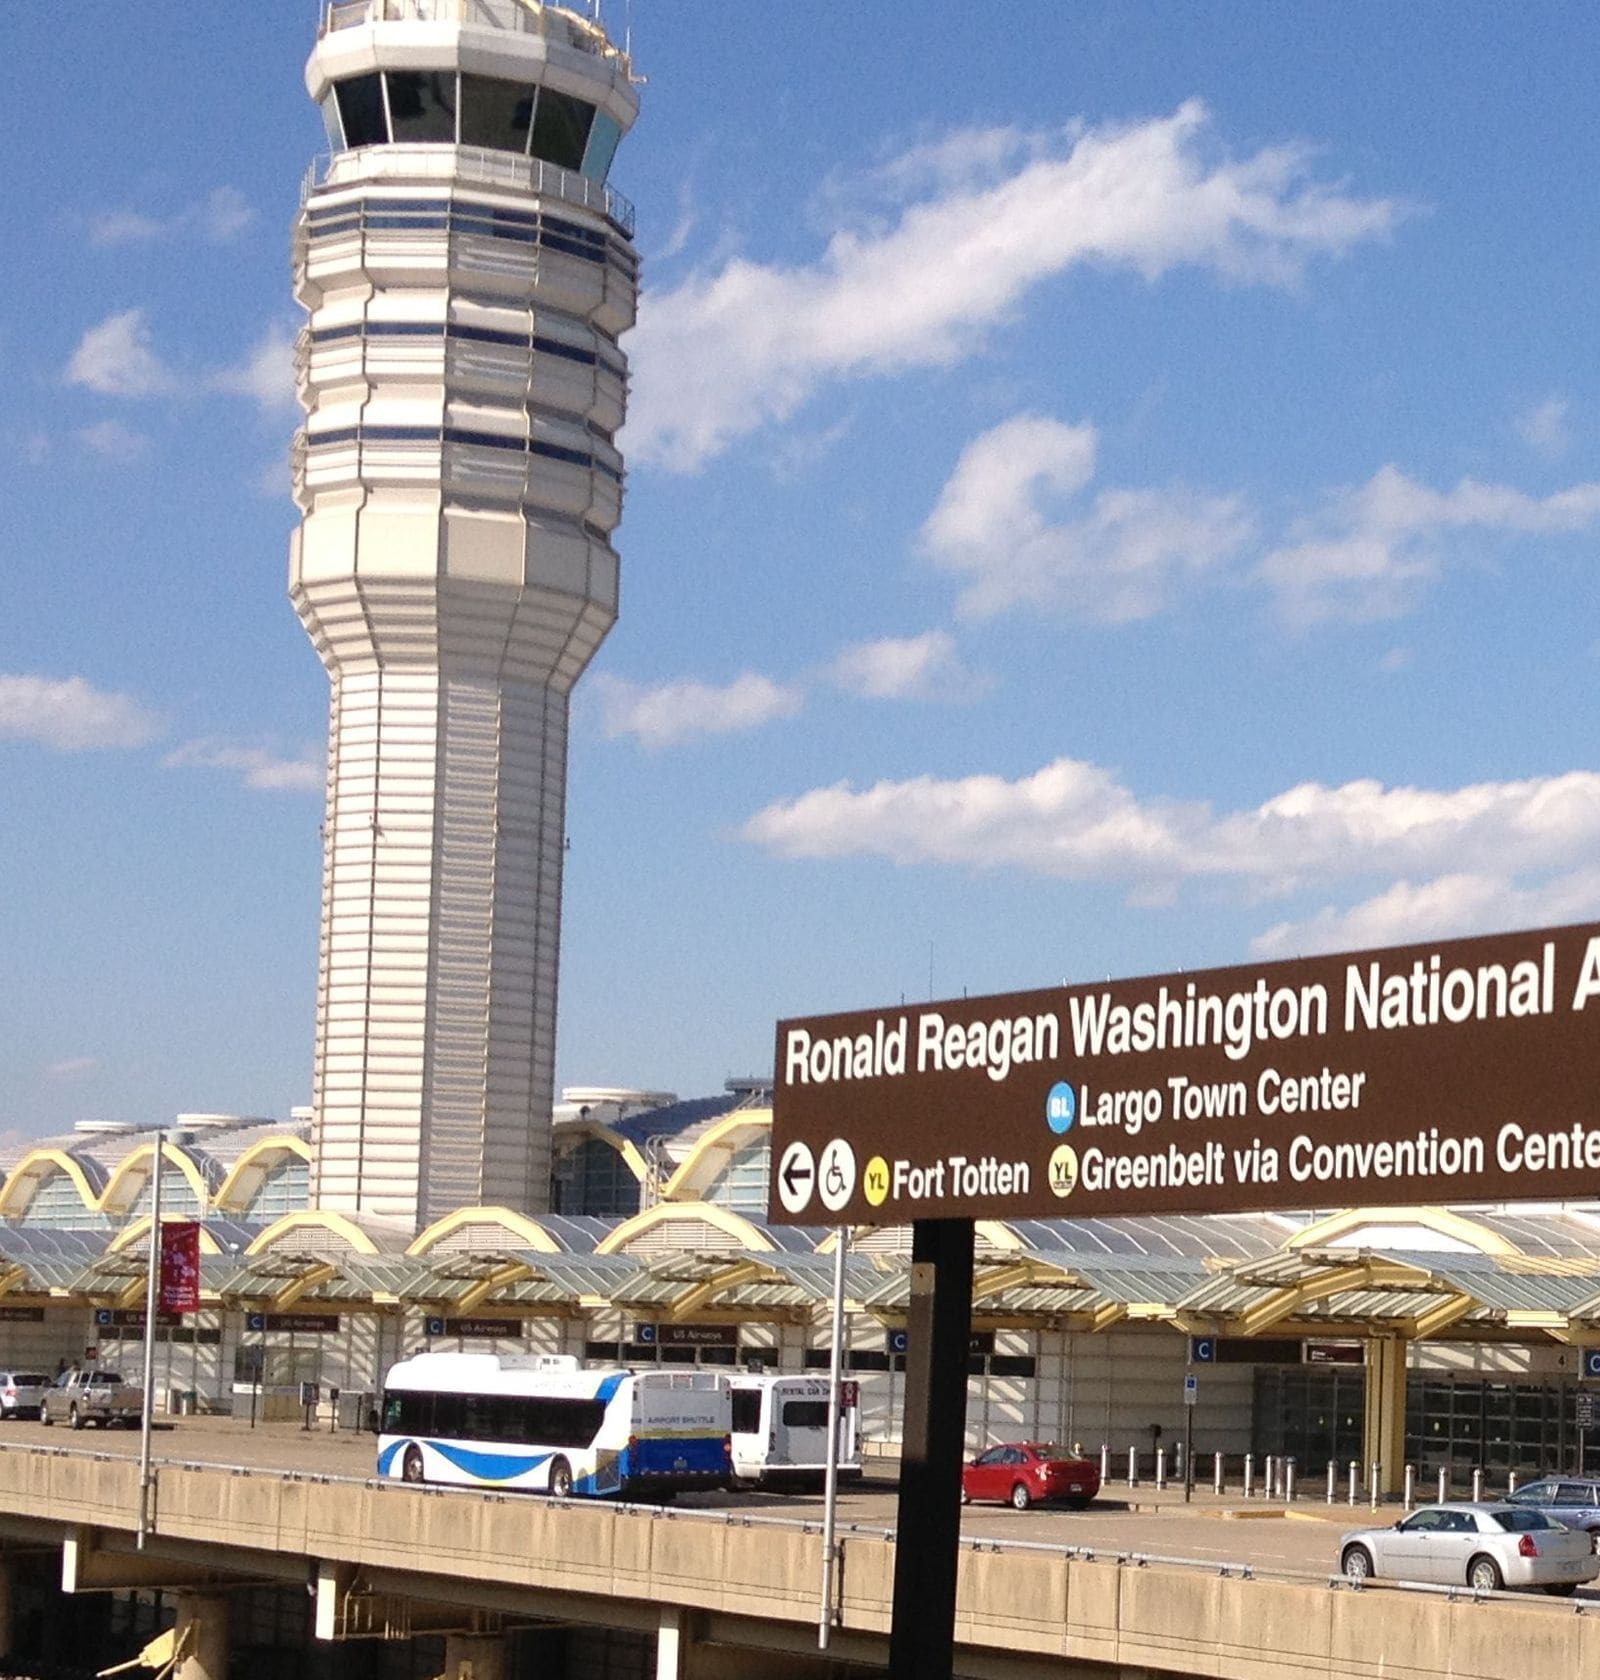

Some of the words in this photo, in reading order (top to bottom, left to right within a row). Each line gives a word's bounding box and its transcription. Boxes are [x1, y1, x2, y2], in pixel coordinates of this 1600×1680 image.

[785, 1017, 907, 1085] Ronald
[917, 1012, 1058, 1081] Reagan
[1069, 978, 1327, 1060] Washington
[1345, 942, 1555, 1032] National
[1051, 1097, 1070, 1118] BL
[1080, 1084, 1162, 1135] Largo
[1167, 1077, 1247, 1120] Town
[1257, 1067, 1366, 1115] Center
[869, 1172, 885, 1190] YL
[893, 1159, 945, 1200] Fort
[949, 1156, 1030, 1197] Totten
[1054, 1162, 1073, 1180] YL
[1081, 1141, 1226, 1191] Greenbelt
[1233, 1138, 1279, 1183] via
[1288, 1127, 1484, 1182] Convention
[641, 1326, 653, 1340] C
[893, 1334, 905, 1348] C
[1198, 1342, 1209, 1358] C
